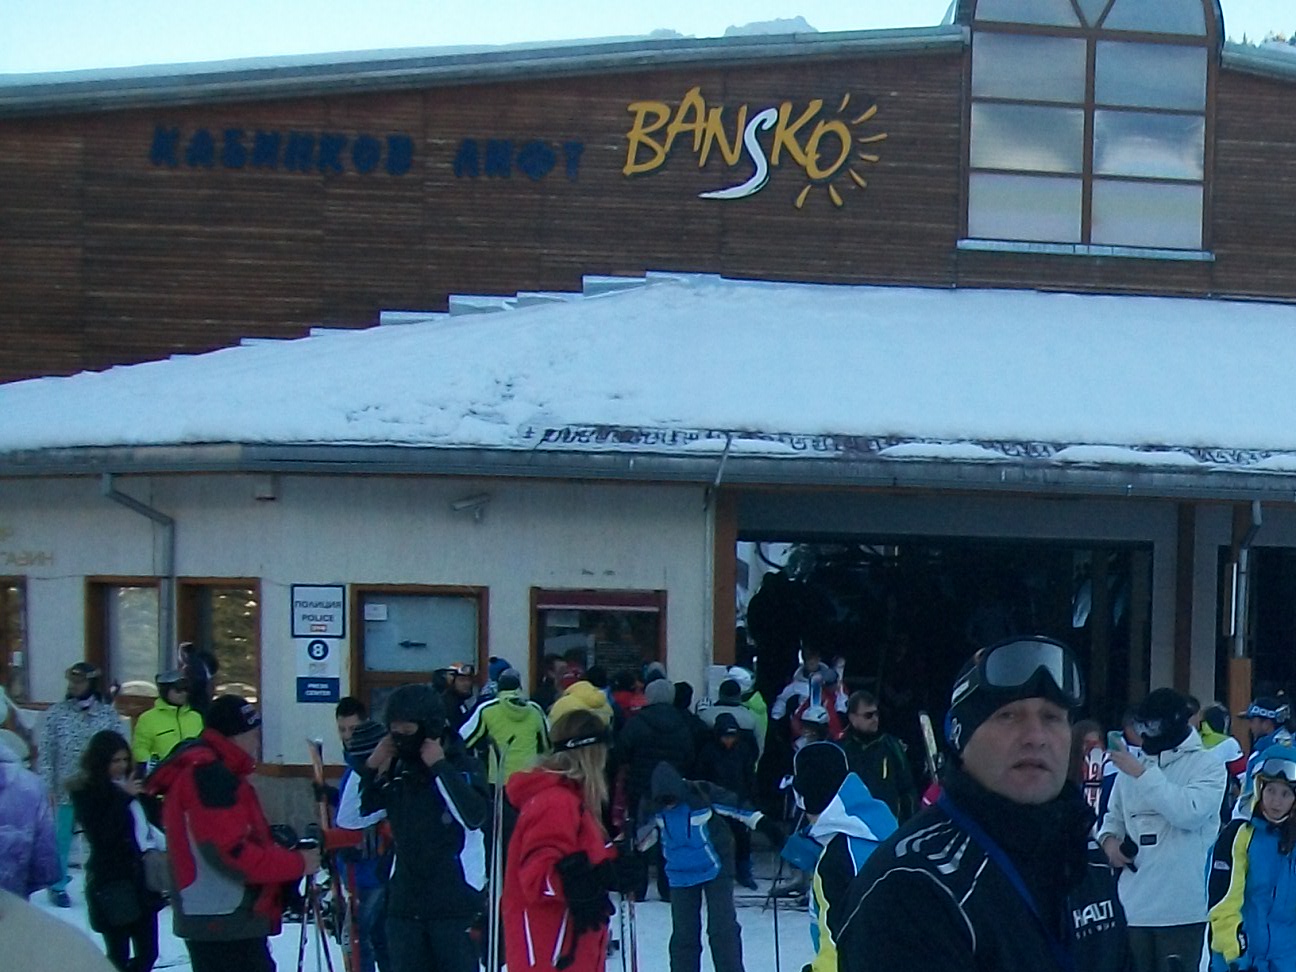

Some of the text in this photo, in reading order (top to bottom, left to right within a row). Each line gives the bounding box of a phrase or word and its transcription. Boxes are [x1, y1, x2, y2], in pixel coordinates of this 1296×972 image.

[623, 86, 852, 199] BANSKO
[294, 600, 341, 609] ПОЛИЦИЯ
[301, 614, 335, 623] POLICE
[312, 643, 325, 658] 8
[1072, 900, 1114, 929] HALTI
